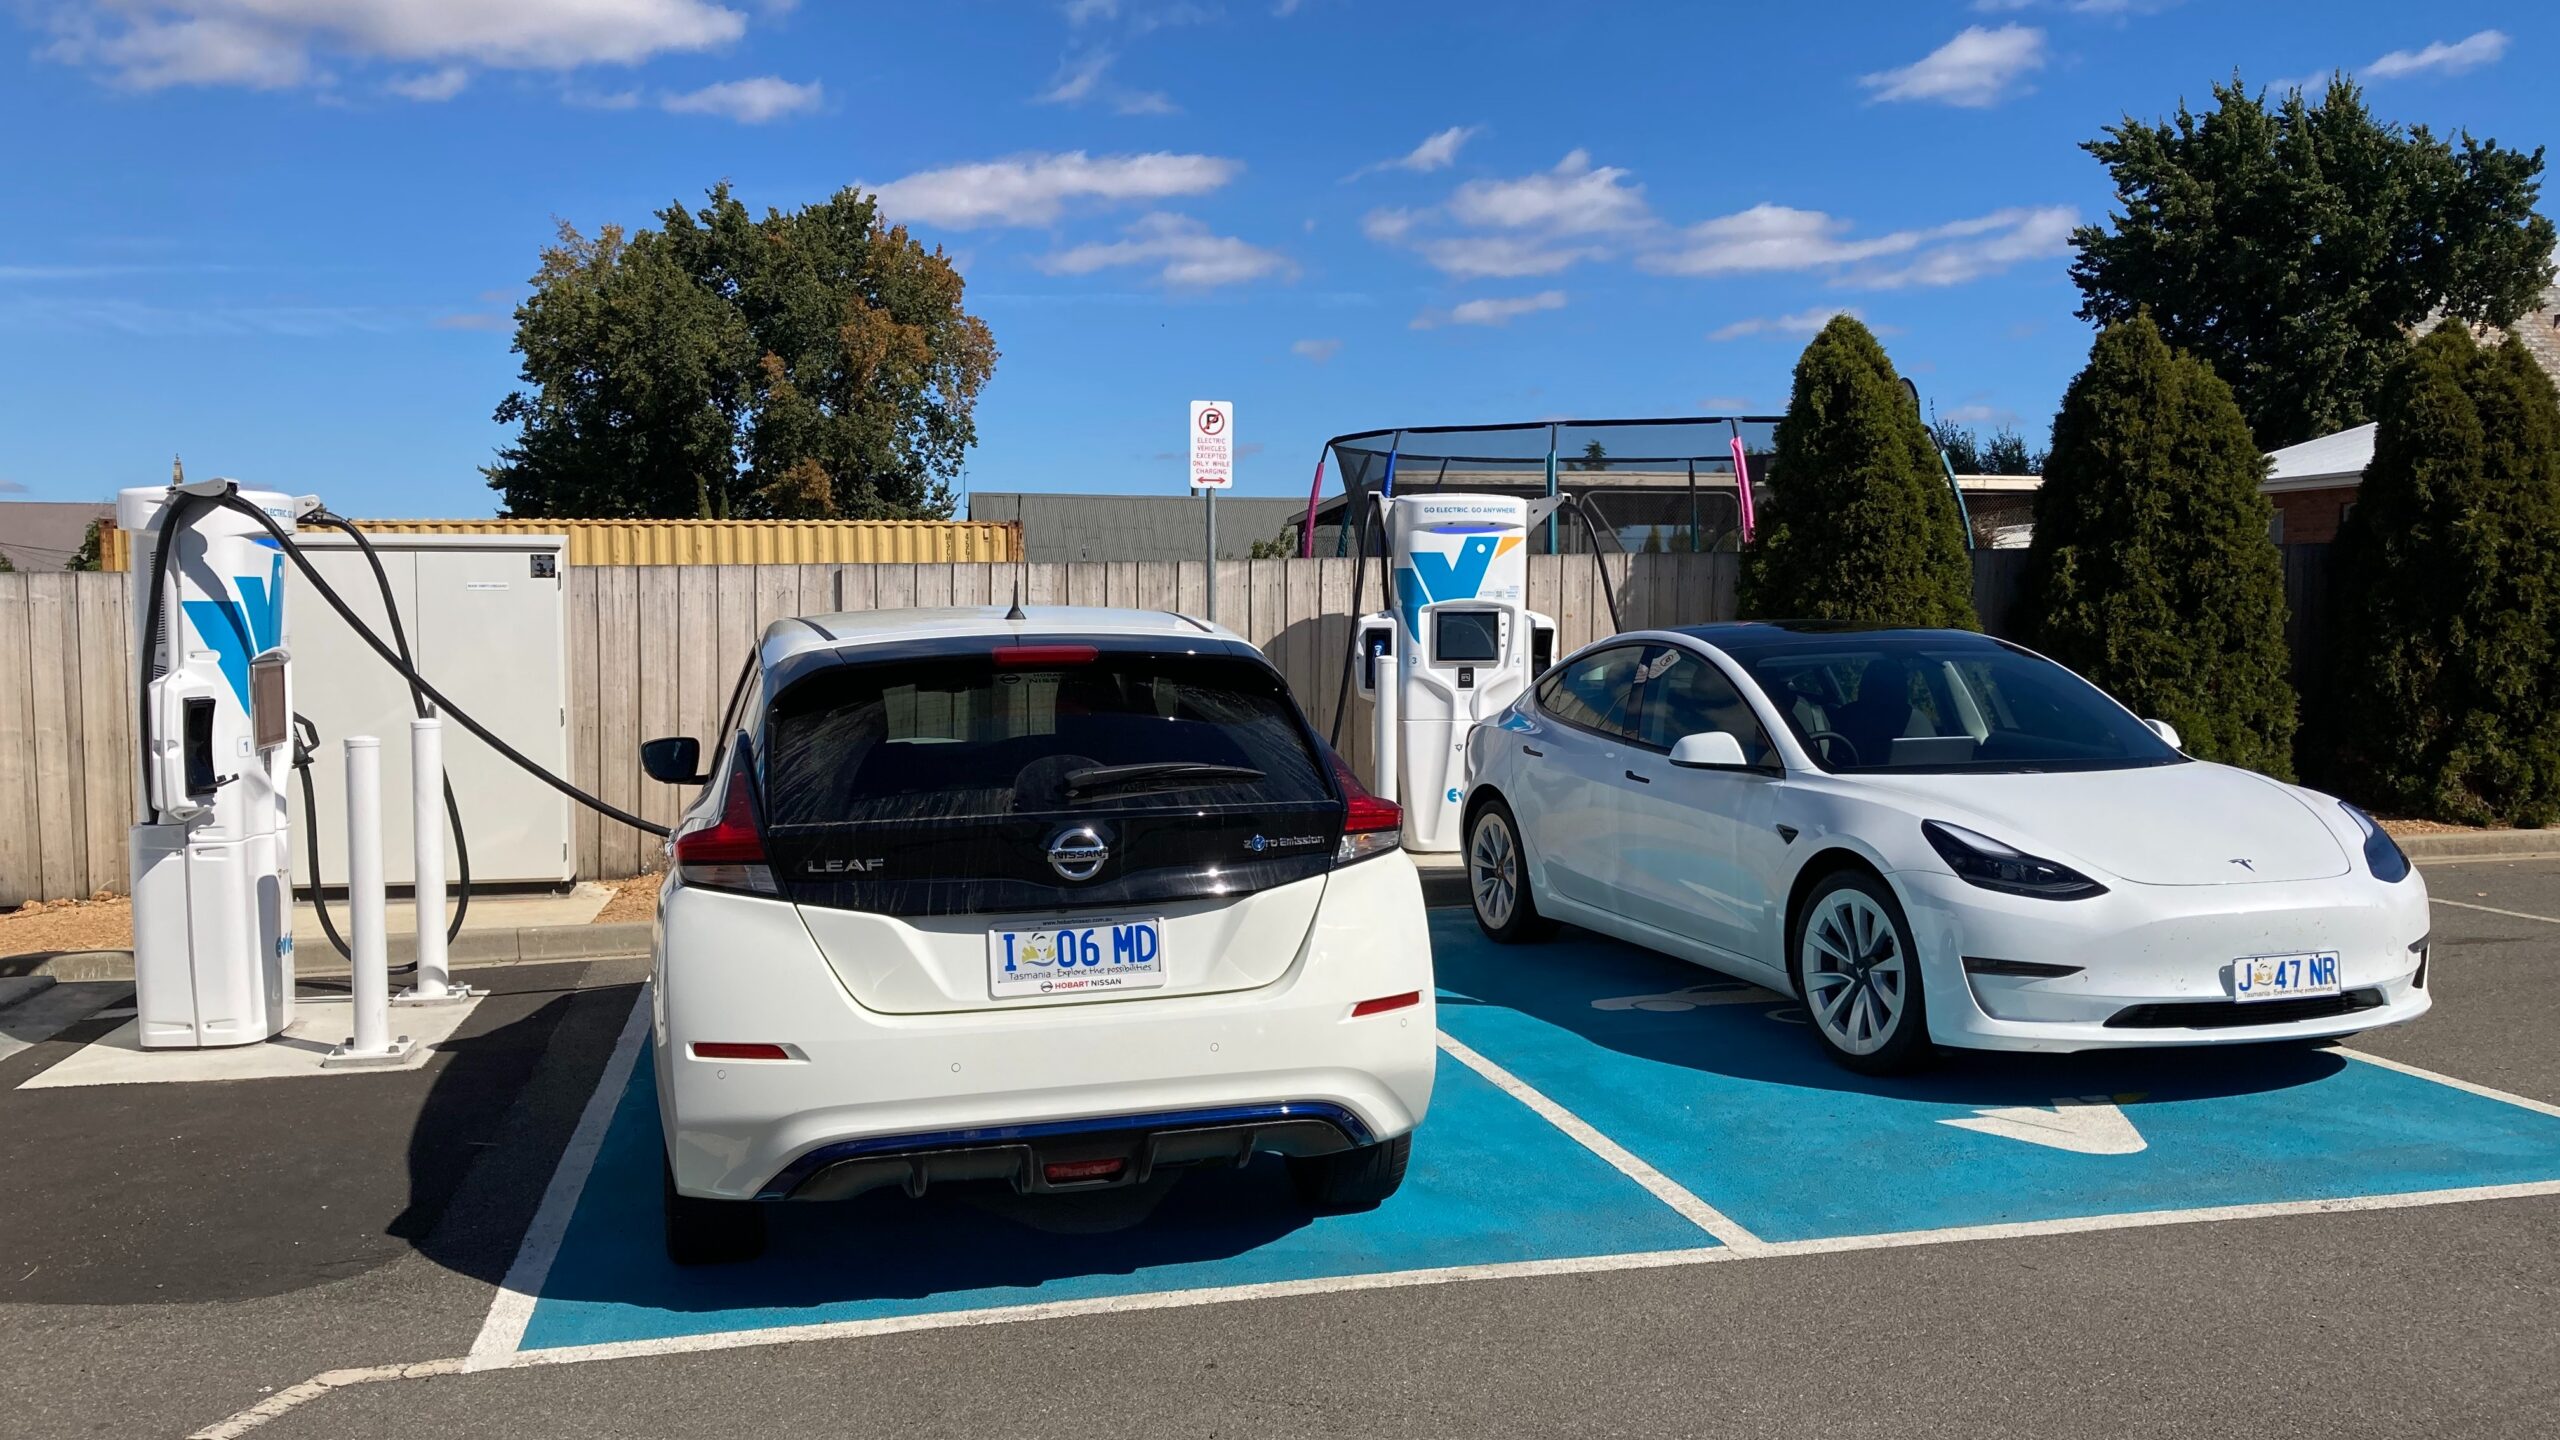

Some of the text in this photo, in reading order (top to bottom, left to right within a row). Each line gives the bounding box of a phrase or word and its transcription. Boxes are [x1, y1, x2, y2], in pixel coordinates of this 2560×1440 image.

[1206, 413, 1219, 429] P
[1411, 656, 1418, 665] 3
[1516, 656, 1521, 664] 4
[243, 741, 249, 753] 1
[1054, 849, 1103, 860] NISSAN
[807, 858, 884, 873] LEAF
[1056, 929, 1101, 968] 06
[1112, 924, 1157, 964] MD
[1009, 972, 1051, 981] Tasmania
[1057, 968, 1087, 978] Explore
[1089, 966, 1105, 975] the
[1107, 964, 1152, 975] possibilities
[2238, 957, 2337, 992] J 47 NR
[1055, 978, 1122, 990] HOBART NISSAN
[2244, 990, 2271, 998] Tasmania
